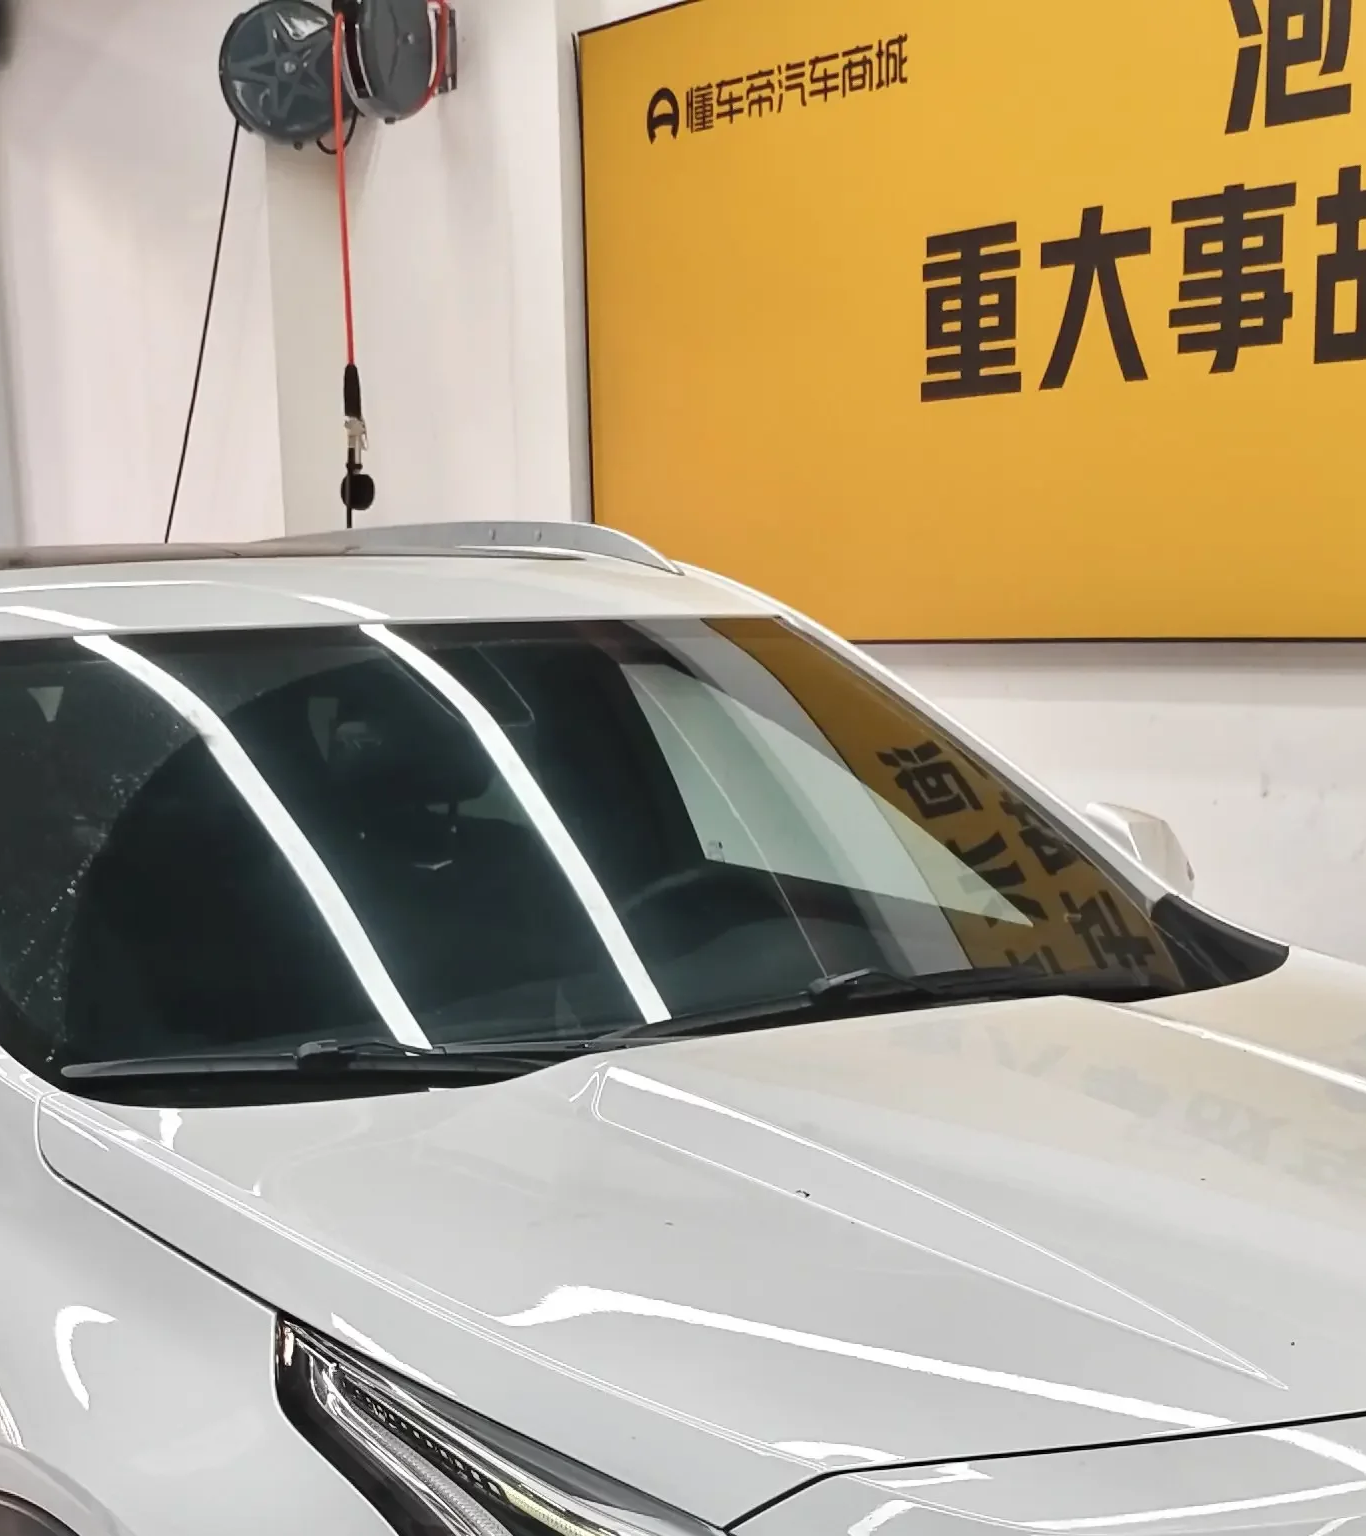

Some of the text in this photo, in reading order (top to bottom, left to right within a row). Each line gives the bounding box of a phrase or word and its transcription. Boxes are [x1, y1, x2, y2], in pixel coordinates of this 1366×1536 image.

[686, 34, 907, 133] 懂车帝汽车商城
